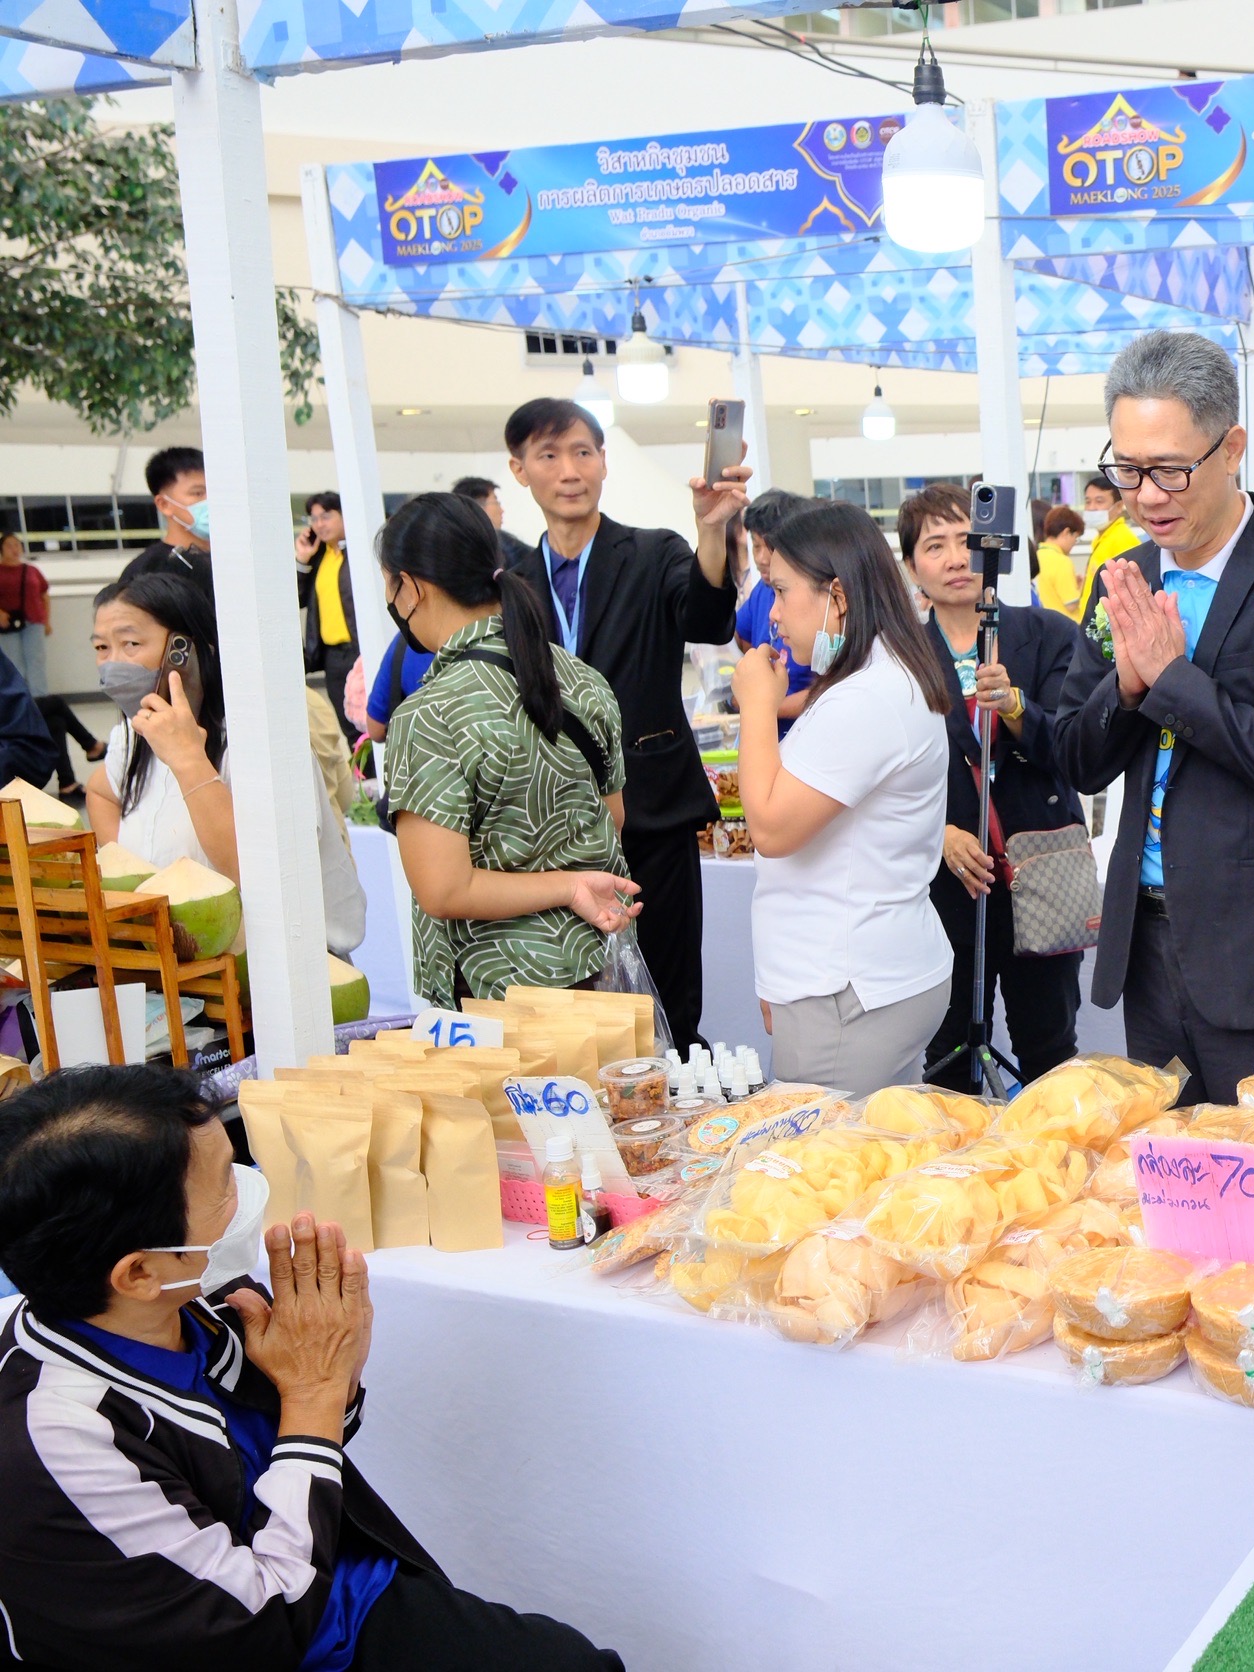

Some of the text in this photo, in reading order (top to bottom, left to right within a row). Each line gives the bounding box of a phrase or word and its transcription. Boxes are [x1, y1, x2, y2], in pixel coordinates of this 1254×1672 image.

[1082, 130, 1160, 148] ROADSHOW
[597, 141, 729, 176] วิสาหกิจชุมชน
[1063, 145, 1184, 187] OTOP
[538, 168, 799, 210] การผลิตการเกษตรปลอดสาร
[1070, 184, 1181, 205] MAEKLONG 2025
[390, 204, 483, 241] OTOP
[608, 200, 726, 225] Wat Pradu Organic
[428, 1016, 476, 1048] 15
[542, 1081, 589, 1117] 60
